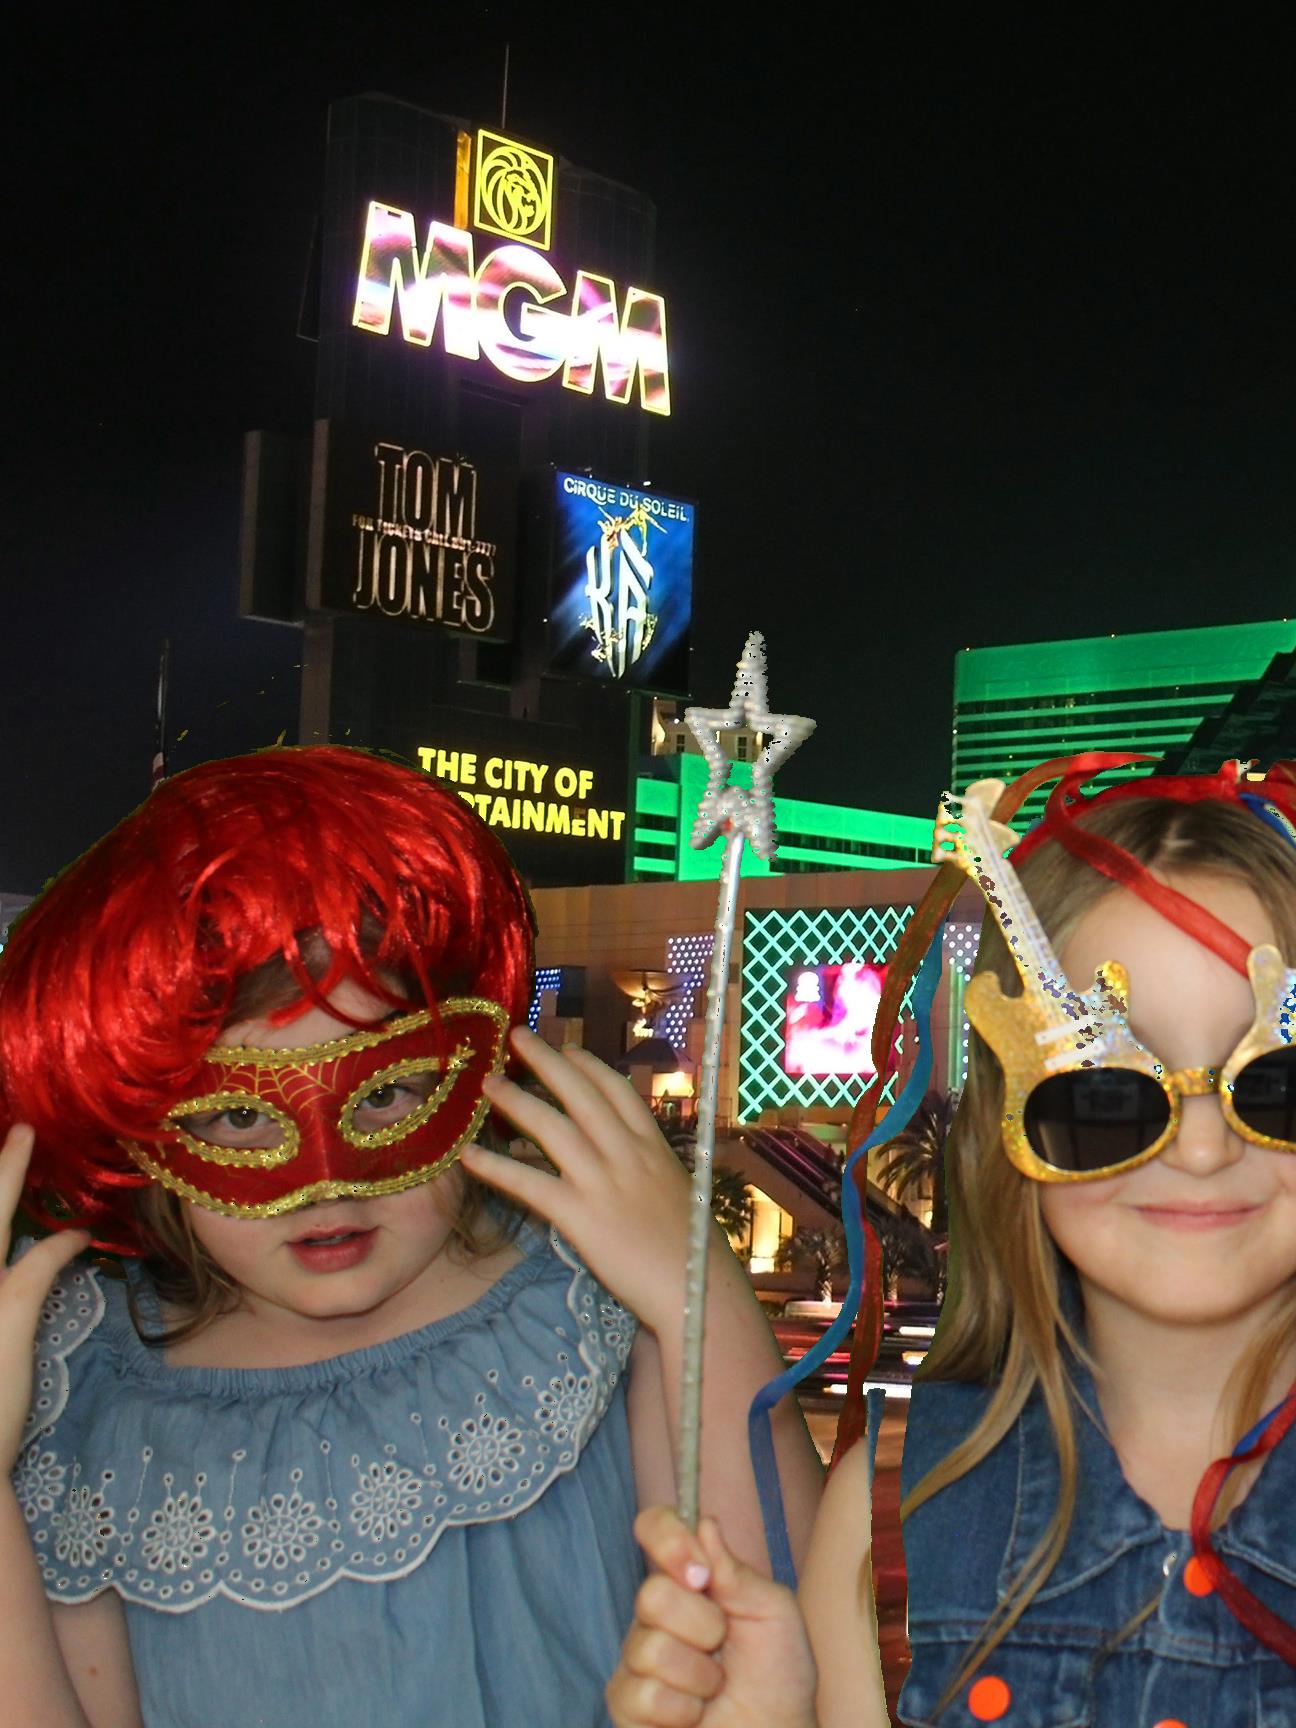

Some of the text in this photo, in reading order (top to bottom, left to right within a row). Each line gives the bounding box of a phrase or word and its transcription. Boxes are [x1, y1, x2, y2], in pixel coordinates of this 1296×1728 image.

[352, 201, 671, 416] MGM
[374, 442, 477, 539] TOM
[563, 477, 688, 522] CIRQUE DU SOLEIL
[353, 529, 495, 632] JONES
[418, 747, 594, 799] THE CITY OF
